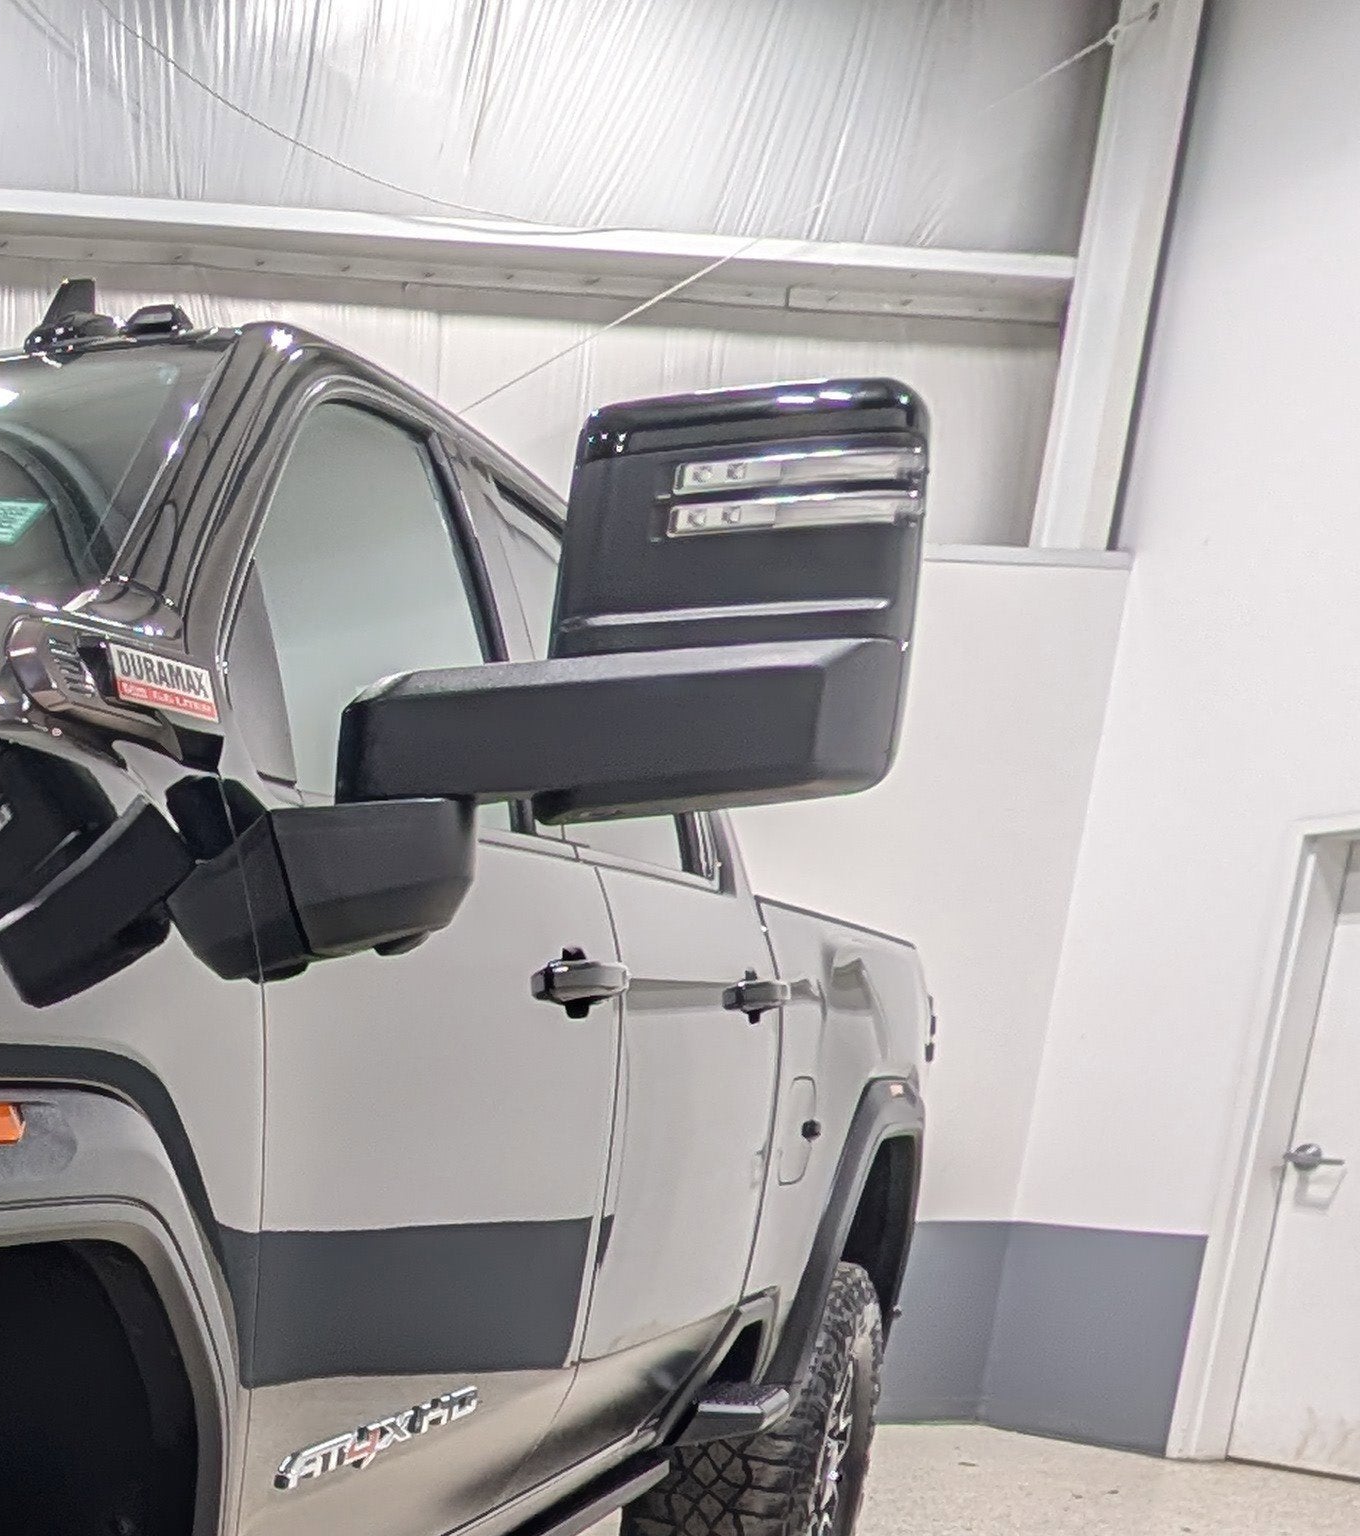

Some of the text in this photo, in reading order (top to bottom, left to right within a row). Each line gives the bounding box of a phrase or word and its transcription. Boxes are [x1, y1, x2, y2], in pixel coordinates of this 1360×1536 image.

[116, 649, 210, 698] DURAMAX
[274, 1385, 478, 1489] AT4X HD
